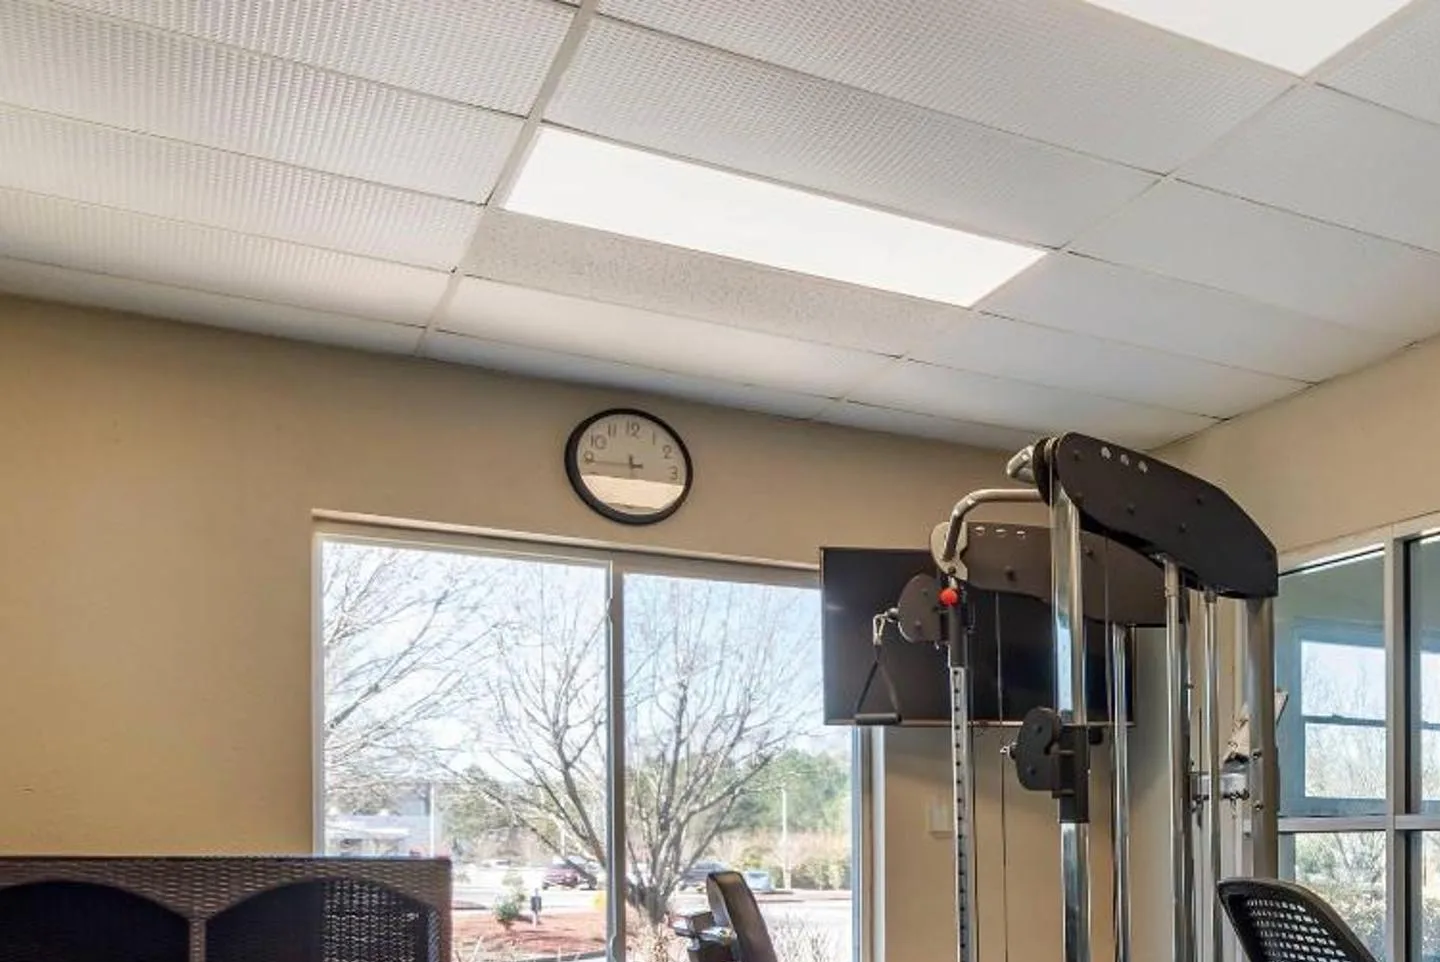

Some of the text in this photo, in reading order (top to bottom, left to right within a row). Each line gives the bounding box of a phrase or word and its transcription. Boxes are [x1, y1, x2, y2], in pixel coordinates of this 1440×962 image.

[607, 422, 618, 438] 11
[625, 420, 641, 439] 12
[590, 432, 608, 450] 10
[662, 445, 673, 460] 2
[668, 465, 679, 481] 3
